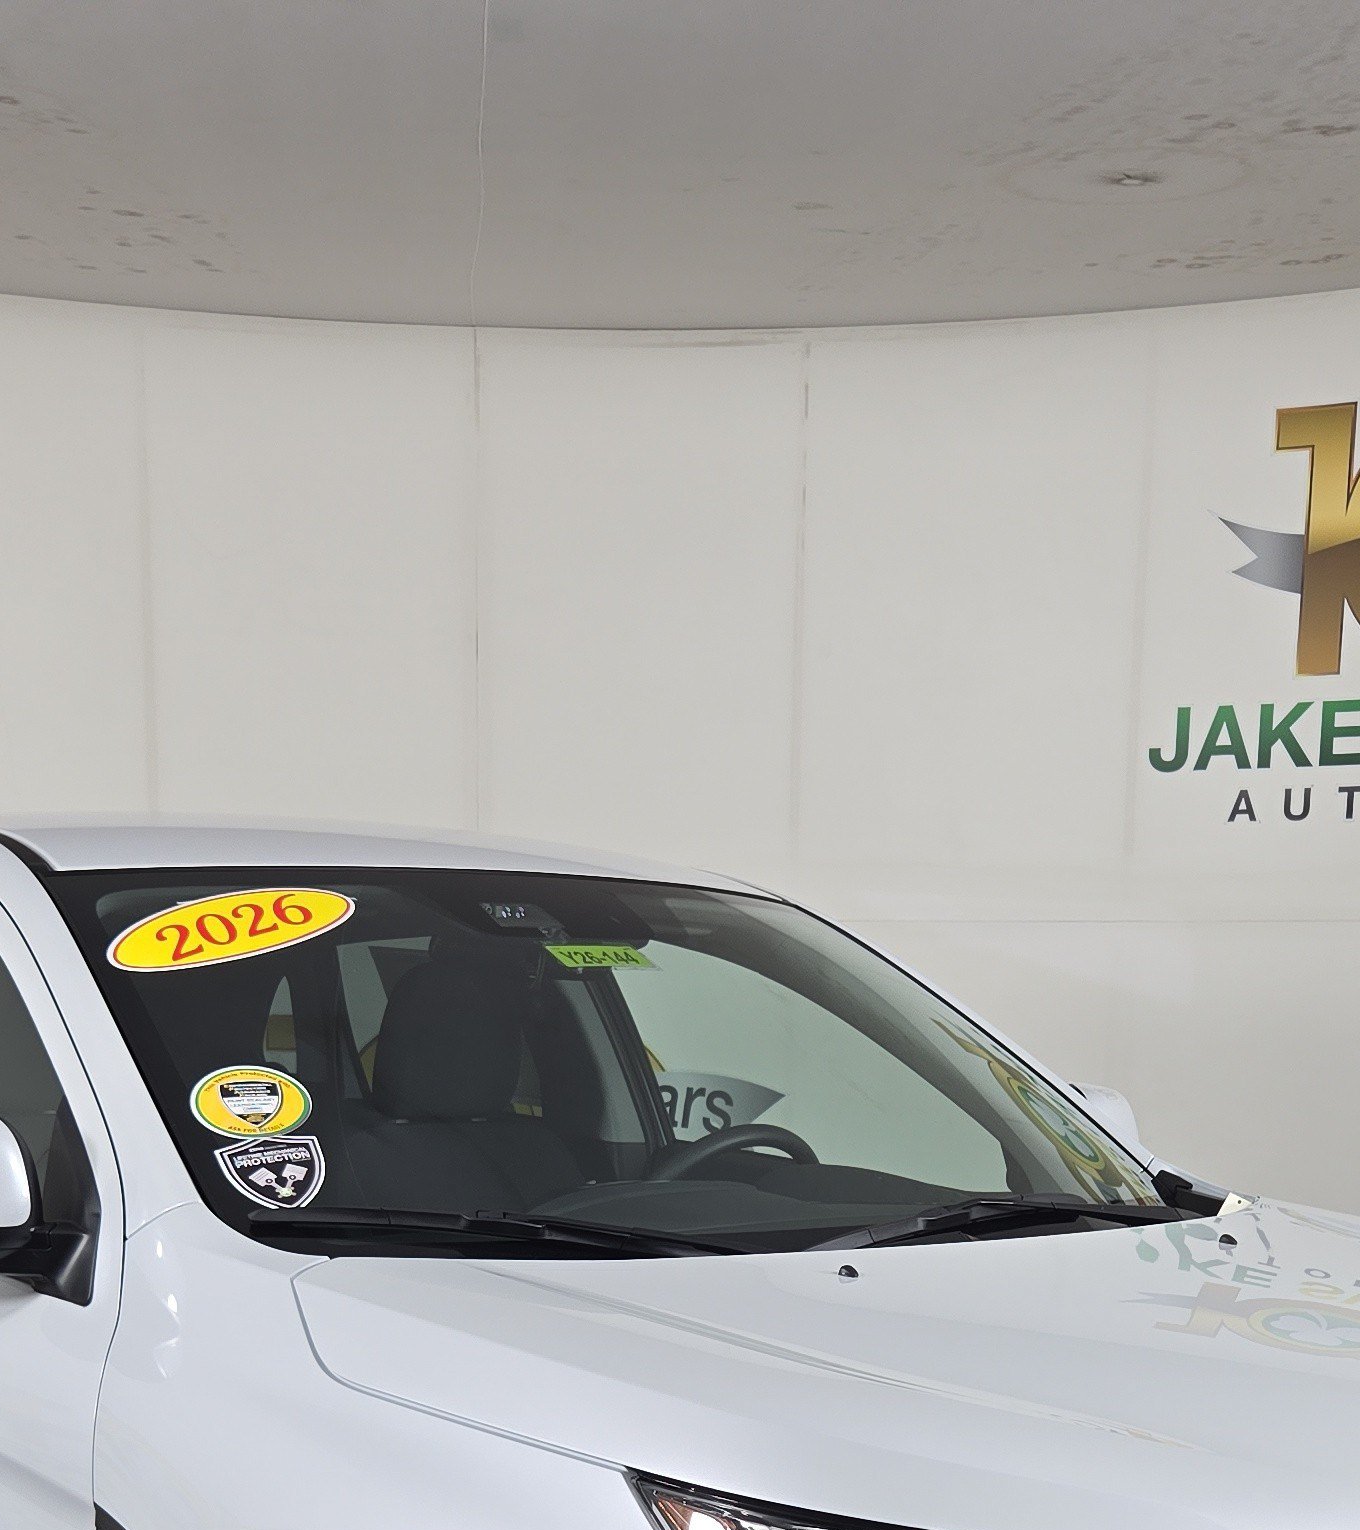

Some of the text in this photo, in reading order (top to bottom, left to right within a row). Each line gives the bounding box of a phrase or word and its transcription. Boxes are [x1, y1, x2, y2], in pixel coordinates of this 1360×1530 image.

[155, 893, 313, 962] 2026
[559, 950, 639, 965] Y26-144
[234, 1151, 311, 1169] PROTECTION
